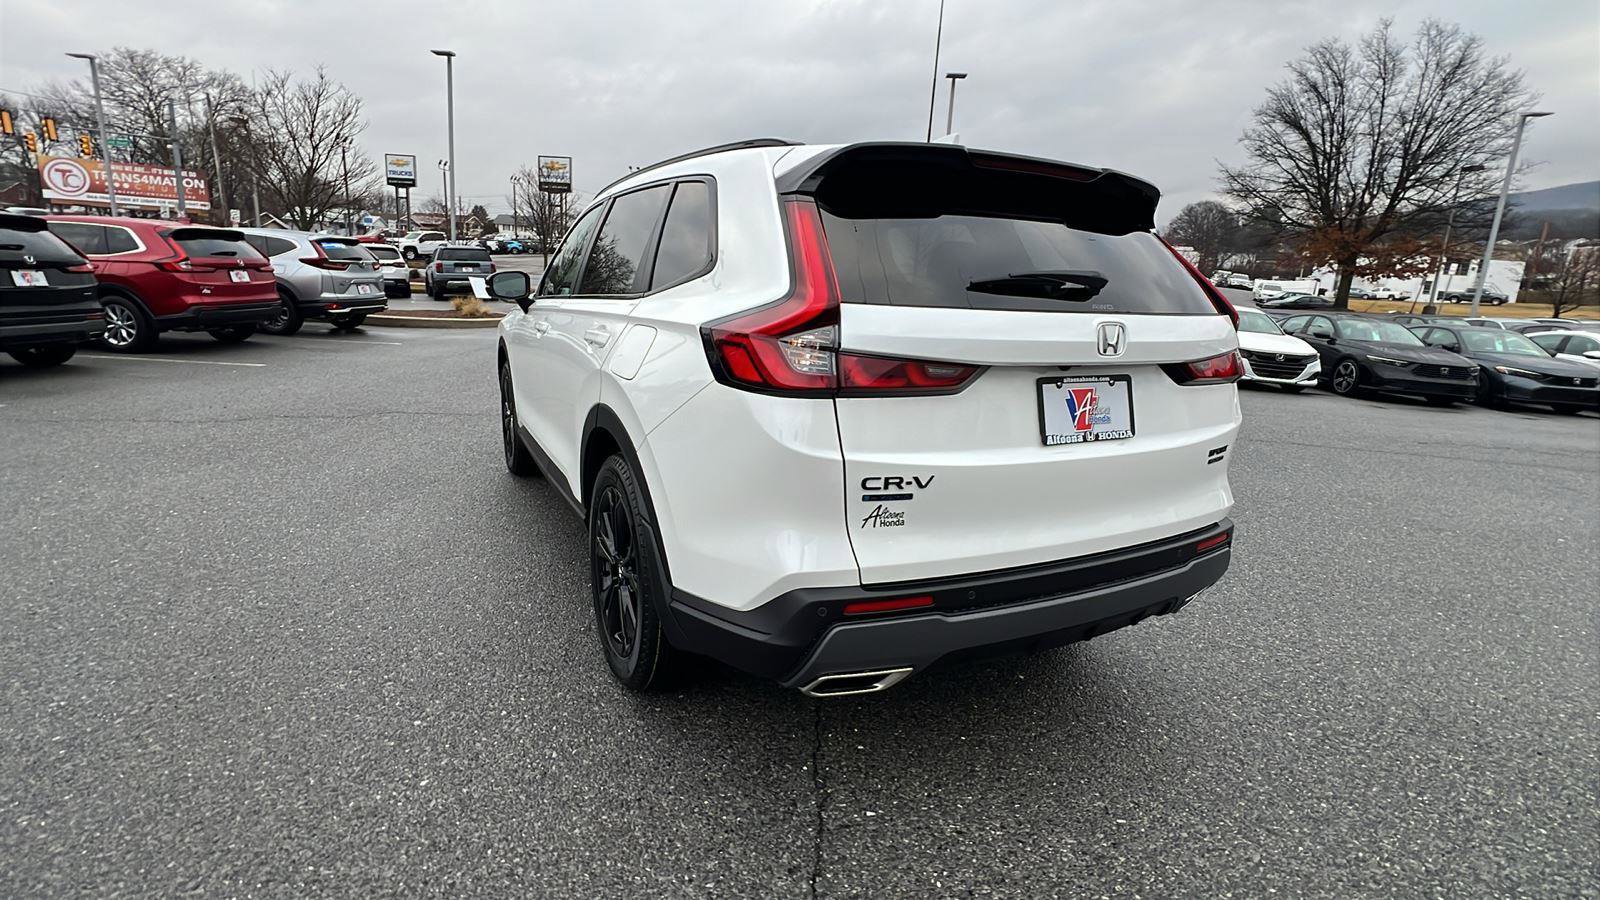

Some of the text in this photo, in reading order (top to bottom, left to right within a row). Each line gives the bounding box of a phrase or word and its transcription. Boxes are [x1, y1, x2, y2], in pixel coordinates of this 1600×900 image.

[91, 169, 205, 189] TRANS4MATON
[388, 169, 413, 177] TRUCKS
[135, 182, 206, 195] CHUCH
[1046, 433, 1084, 445] Altoona
[1098, 430, 1134, 440] HONDA
[861, 475, 935, 491] CR-V
[880, 519, 905, 528] Honda
